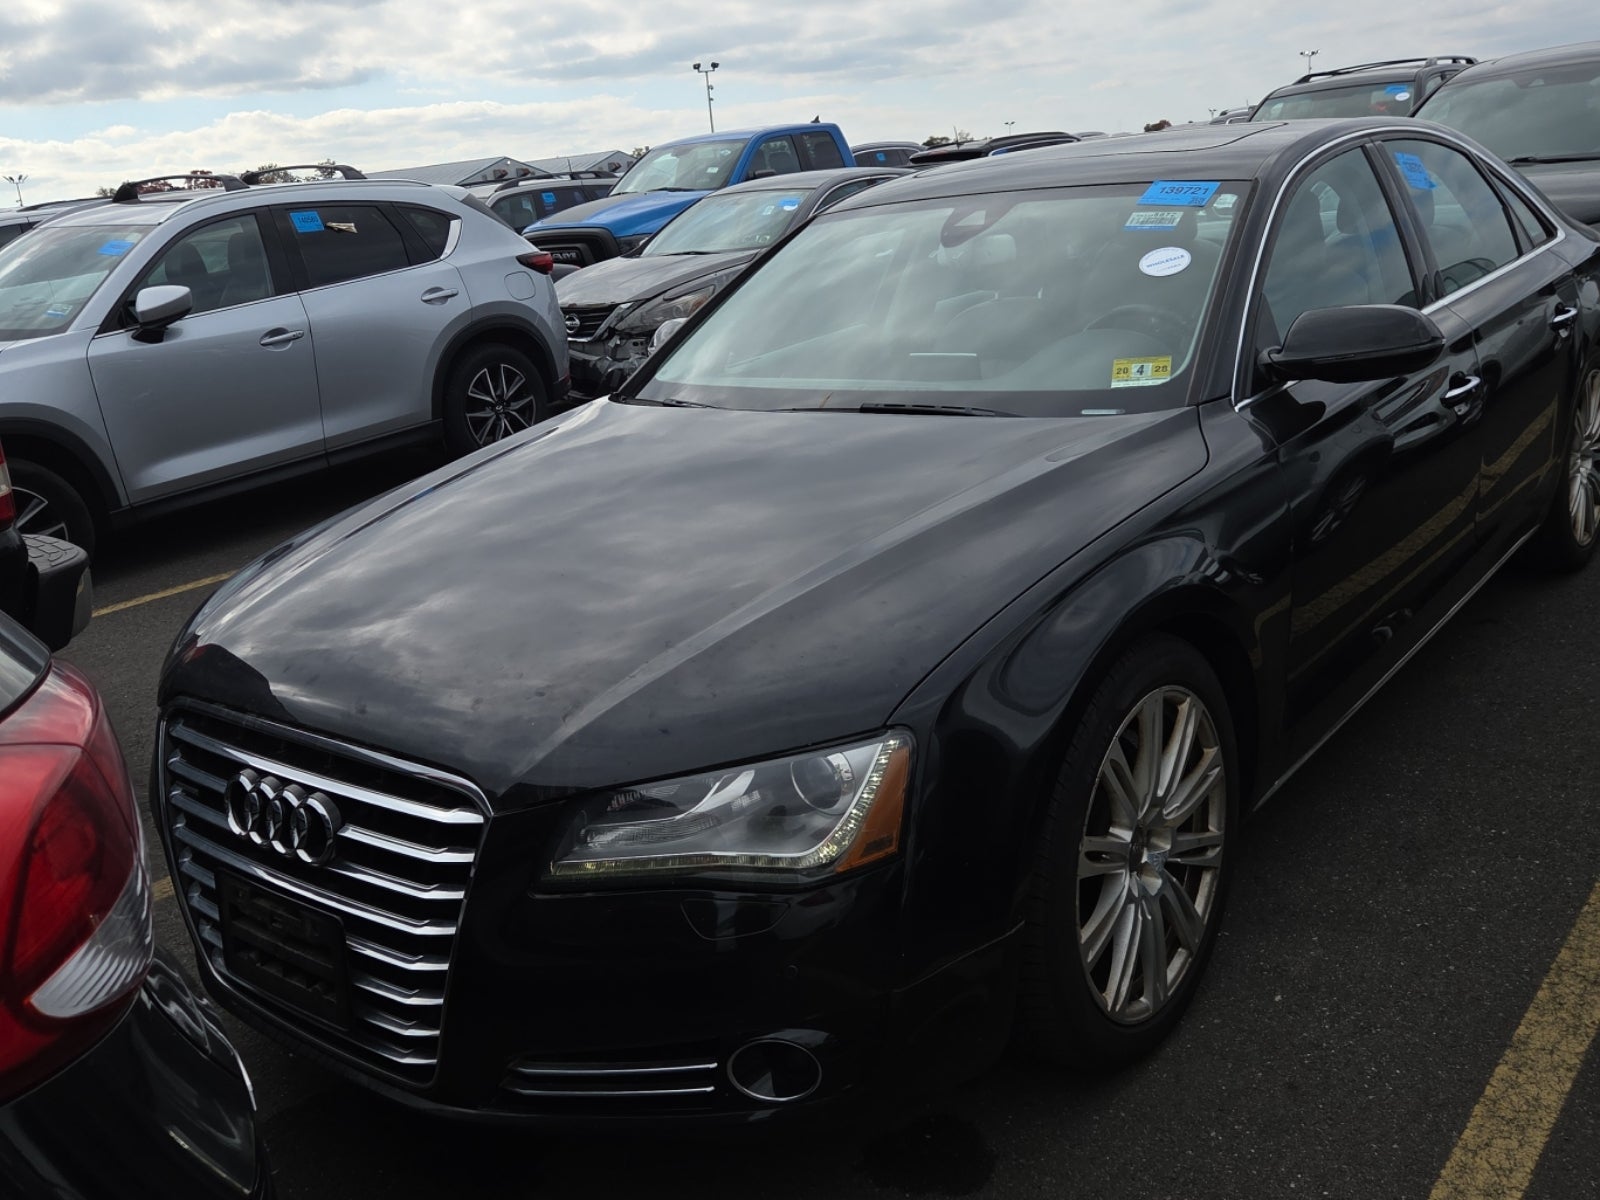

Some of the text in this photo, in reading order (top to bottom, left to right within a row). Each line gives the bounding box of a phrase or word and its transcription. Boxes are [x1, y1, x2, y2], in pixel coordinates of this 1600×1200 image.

[1159, 186, 1209, 195] 139721
[1146, 254, 1186, 268] WHOLESALE
[1116, 367, 1129, 375] 20
[1136, 364, 1145, 376] 4
